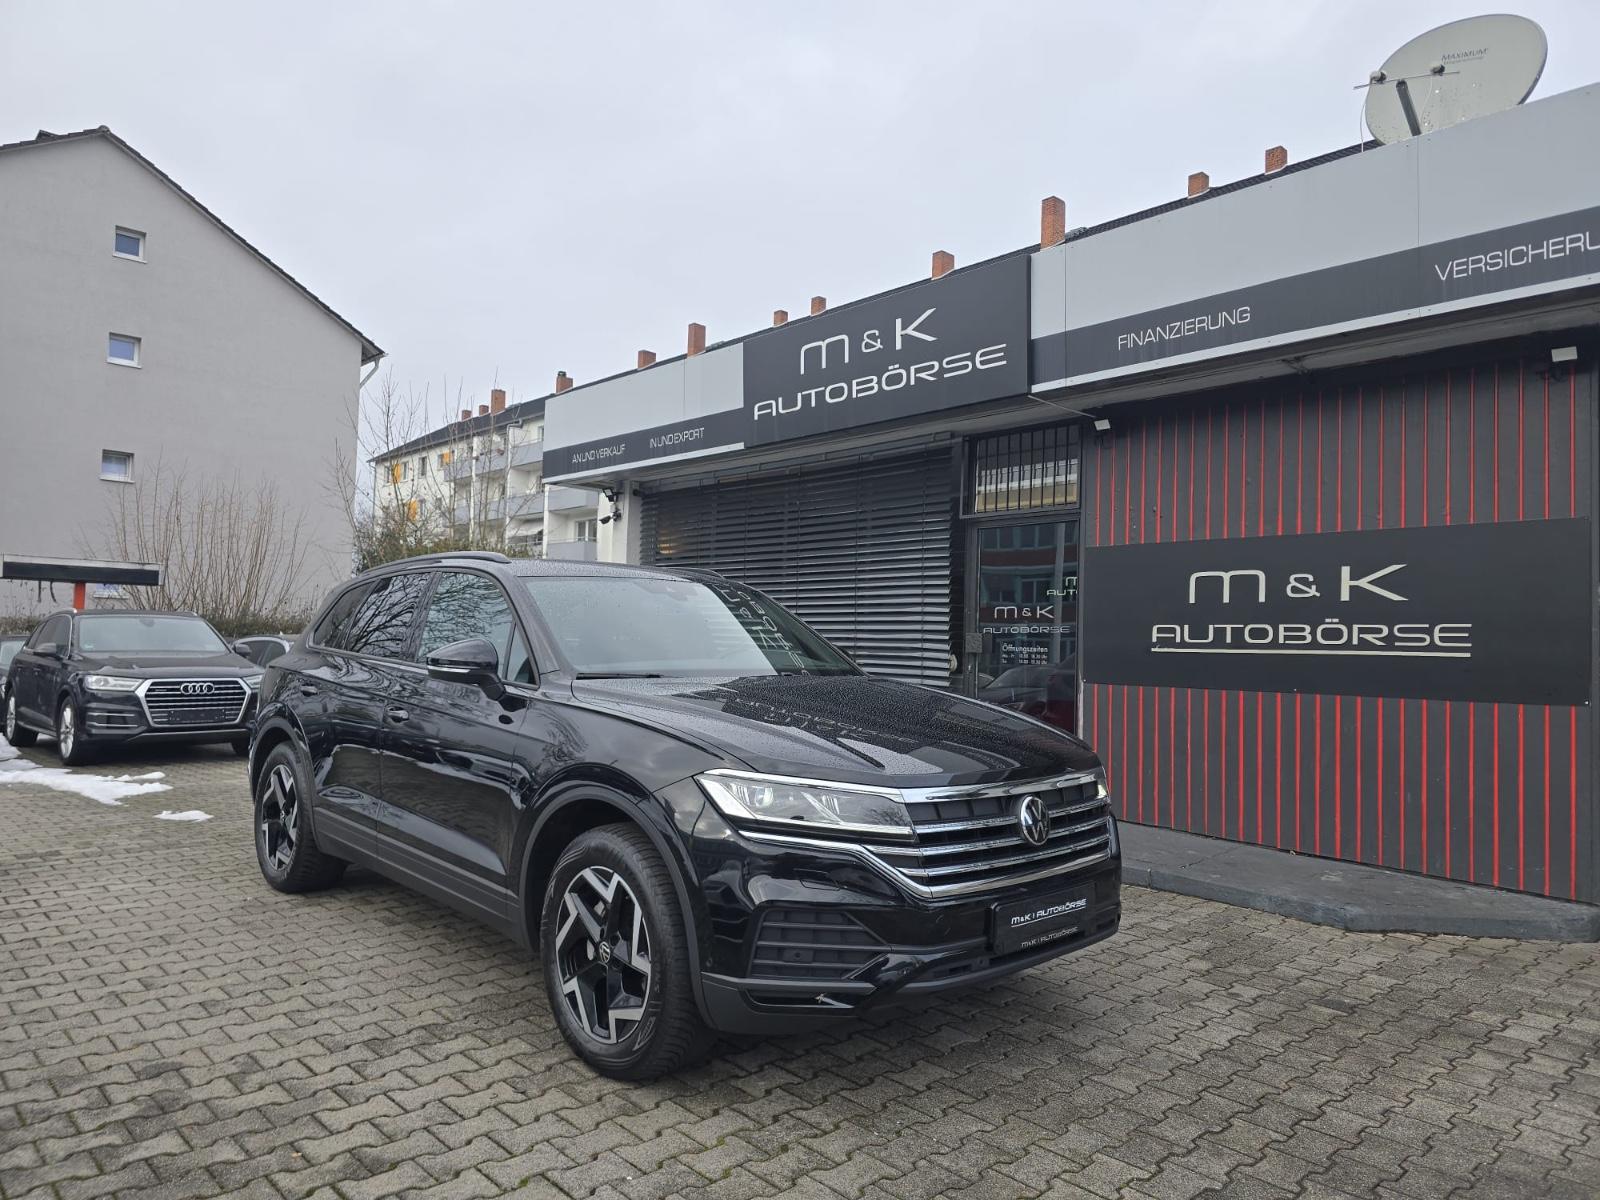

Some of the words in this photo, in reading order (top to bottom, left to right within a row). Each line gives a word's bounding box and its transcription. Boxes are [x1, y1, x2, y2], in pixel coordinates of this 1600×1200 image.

[800, 334, 849, 376] M
[861, 329, 883, 353] &
[895, 307, 939, 351] K
[1118, 306, 1251, 351] FINANZIERUNG
[753, 343, 1007, 421] AUTOBÖRSE
[1189, 569, 1266, 604] M
[1286, 573, 1320, 598] &
[1340, 563, 1409, 601] K
[994, 605, 1018, 619] M
[1022, 607, 1032, 617] &
[1036, 605, 1055, 619] K
[1152, 618, 1473, 647] AUTOBÖRSE
